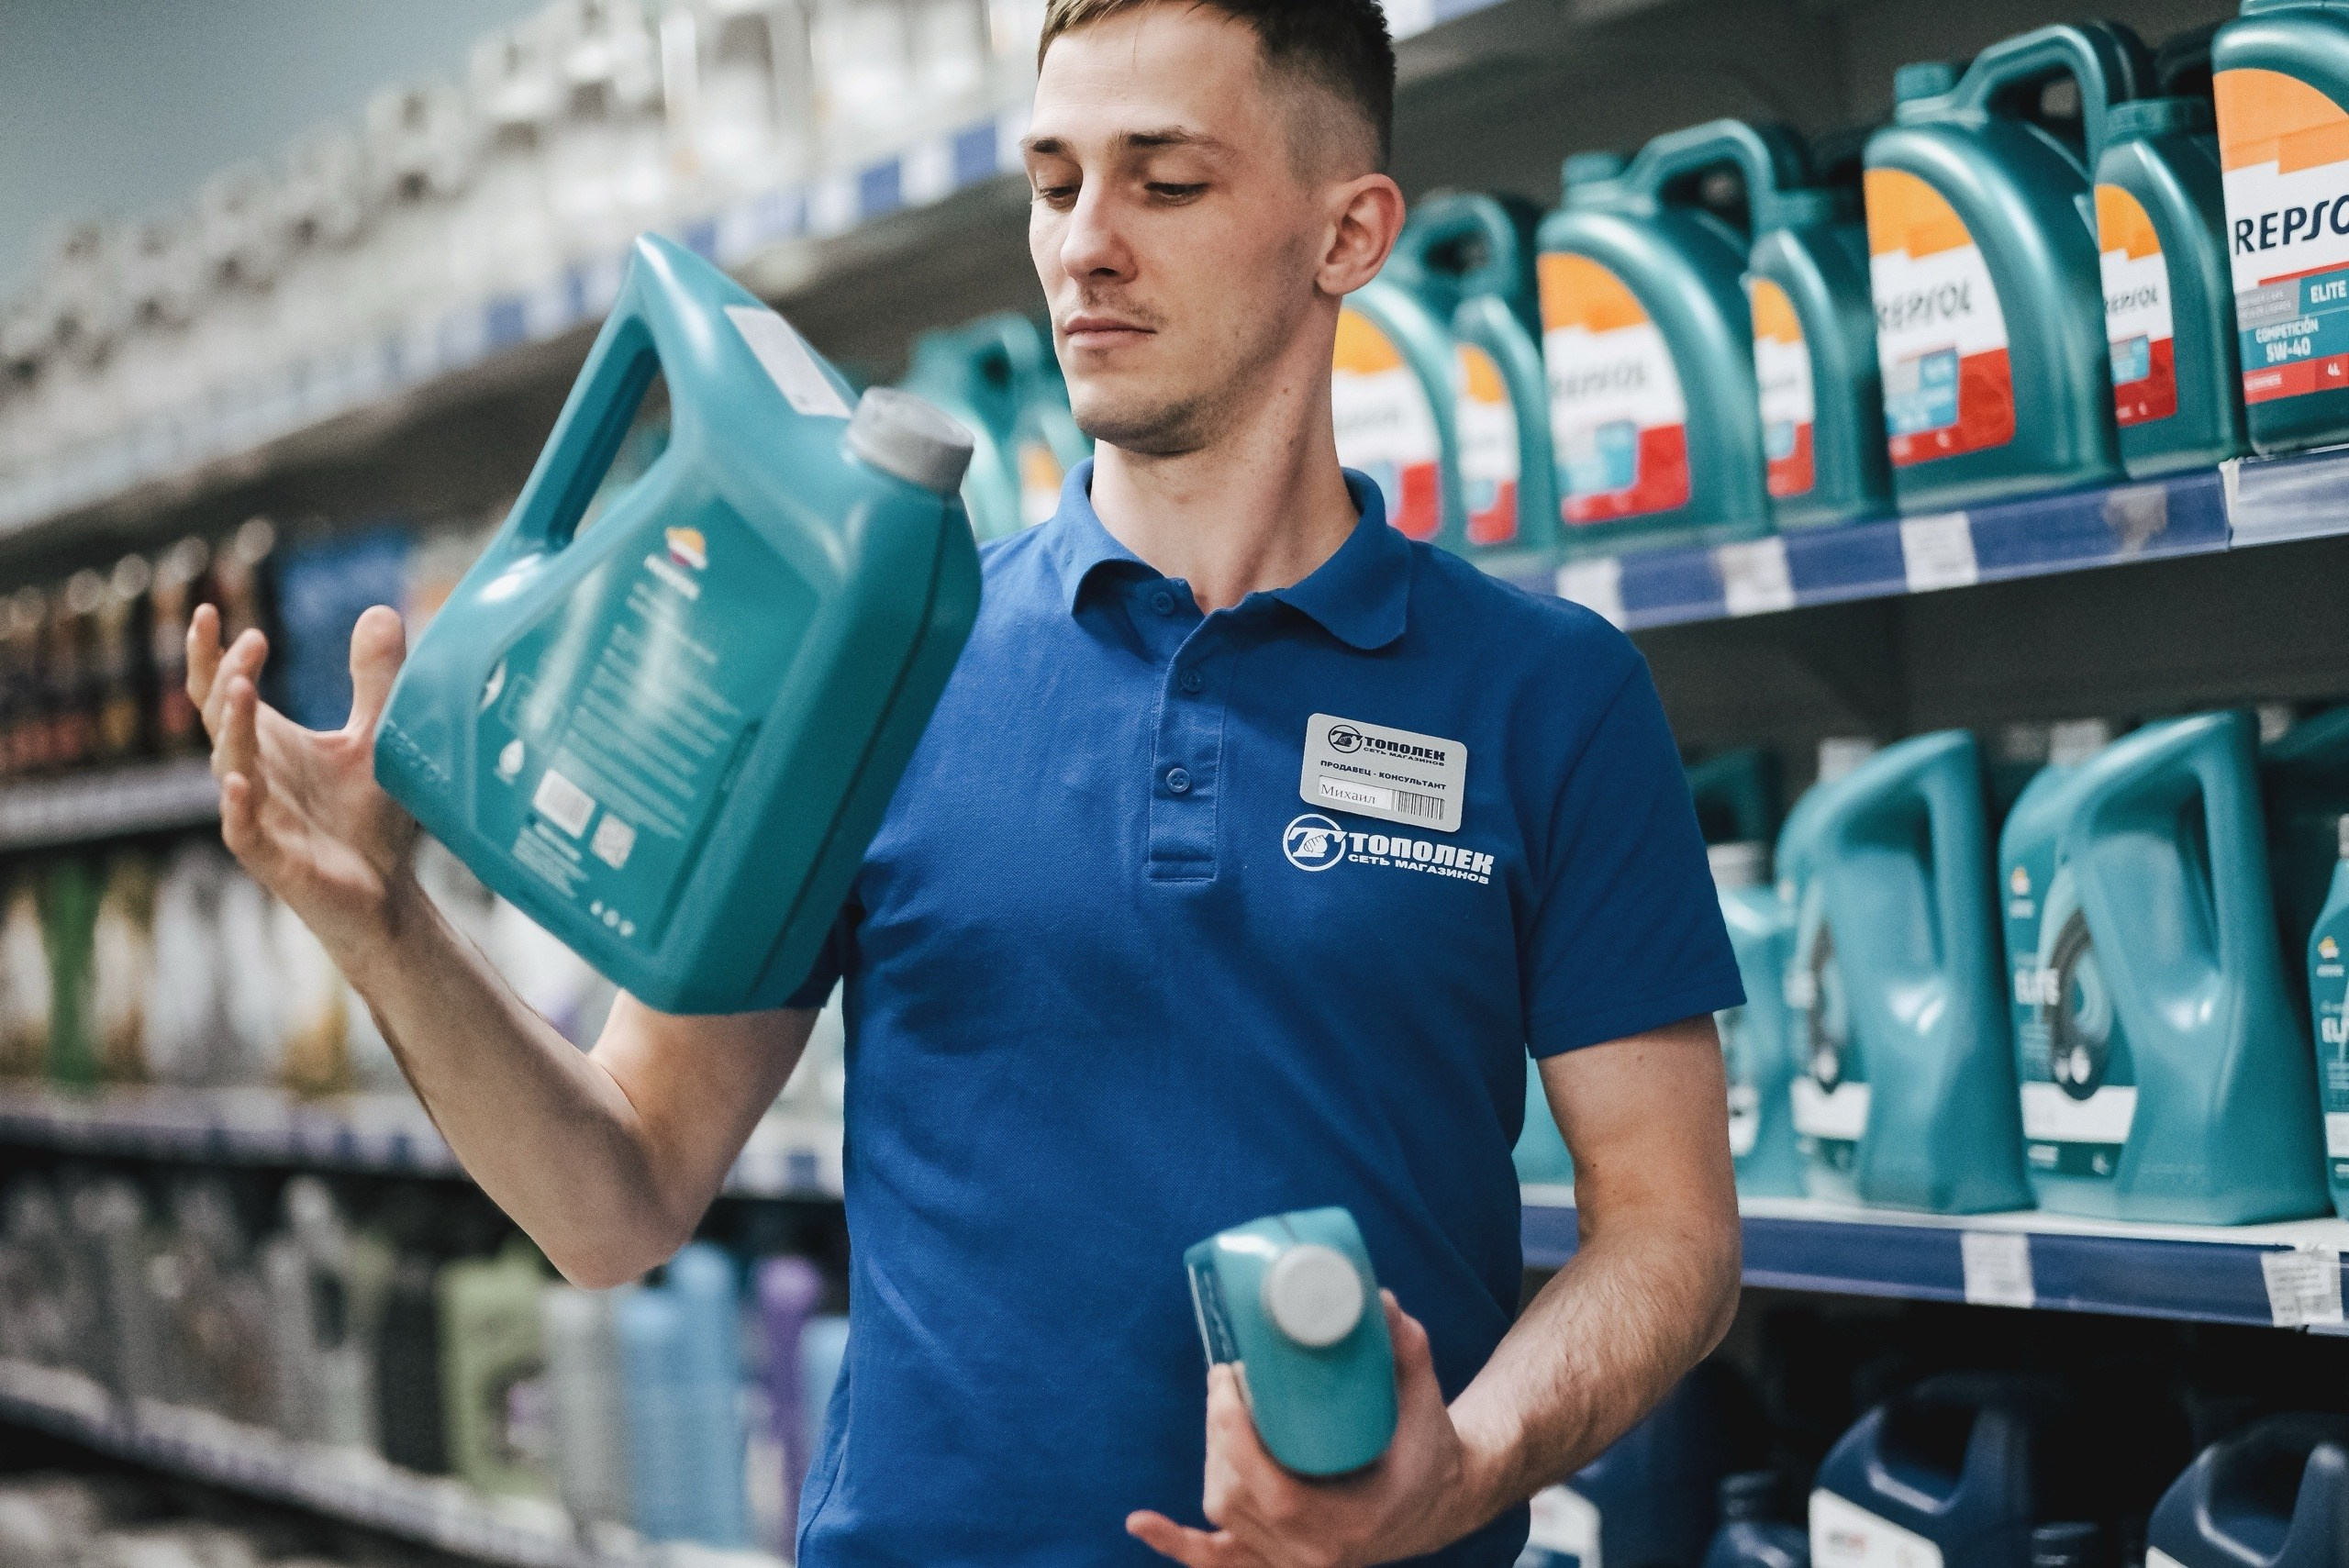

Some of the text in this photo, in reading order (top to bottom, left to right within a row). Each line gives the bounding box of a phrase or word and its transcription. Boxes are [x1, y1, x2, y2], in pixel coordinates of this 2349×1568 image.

[2310, 279, 2347, 304] ELITE
[1363, 747, 1445, 767] СЕТЬ МАГАЗИНОВ
[1364, 736, 1445, 762] ТОПОЛЕК
[1319, 760, 1371, 776] ПРОДАВЕЦ
[1378, 771, 1446, 791] КОНСУЛЬТАНТ
[1320, 783, 1376, 805] Михаил
[1349, 833, 1494, 875] ТОПОЛЕК
[1347, 853, 1490, 884] СЕТЬ МАГАЗИНОВ
